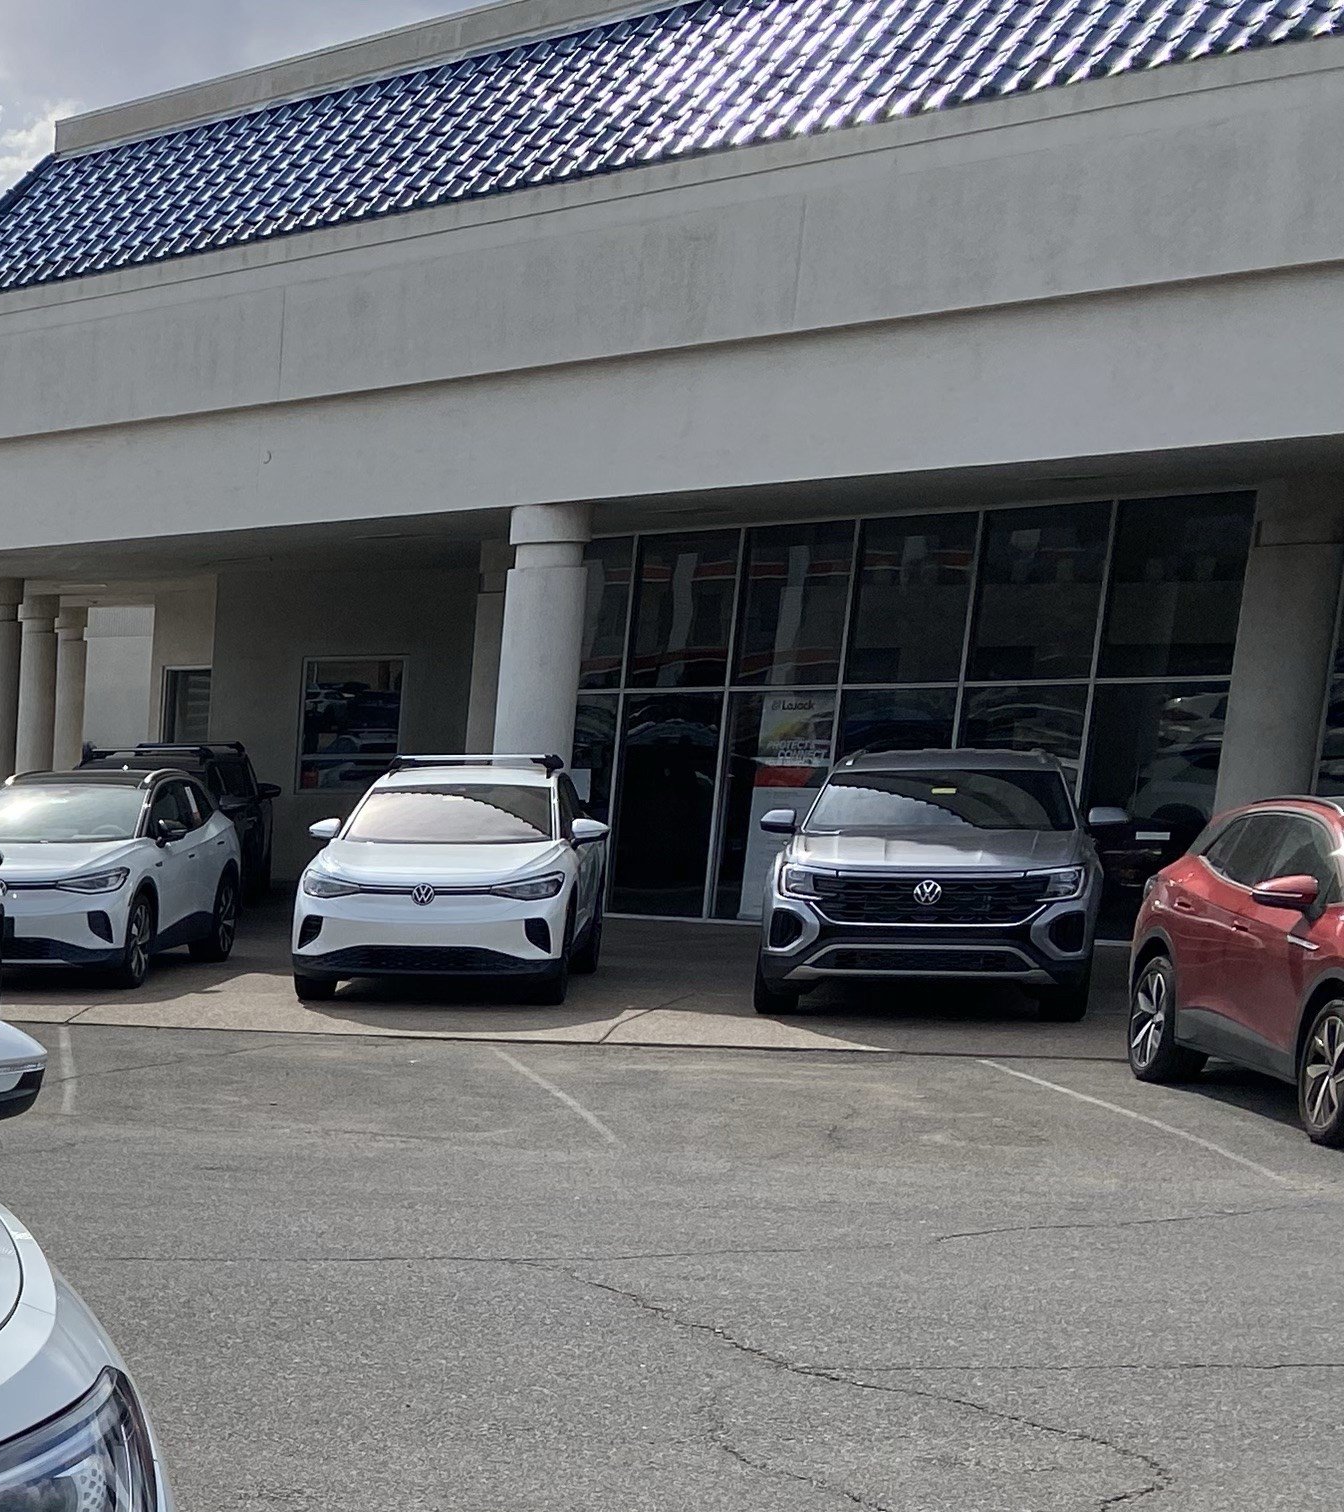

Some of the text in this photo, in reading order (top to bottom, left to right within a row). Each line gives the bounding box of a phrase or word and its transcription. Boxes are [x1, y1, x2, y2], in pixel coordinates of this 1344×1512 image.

[766, 739, 810, 750] PROTECT
[777, 749, 828, 760] CONNECT
[412, 883, 435, 906] VW
[913, 879, 942, 906] VW
